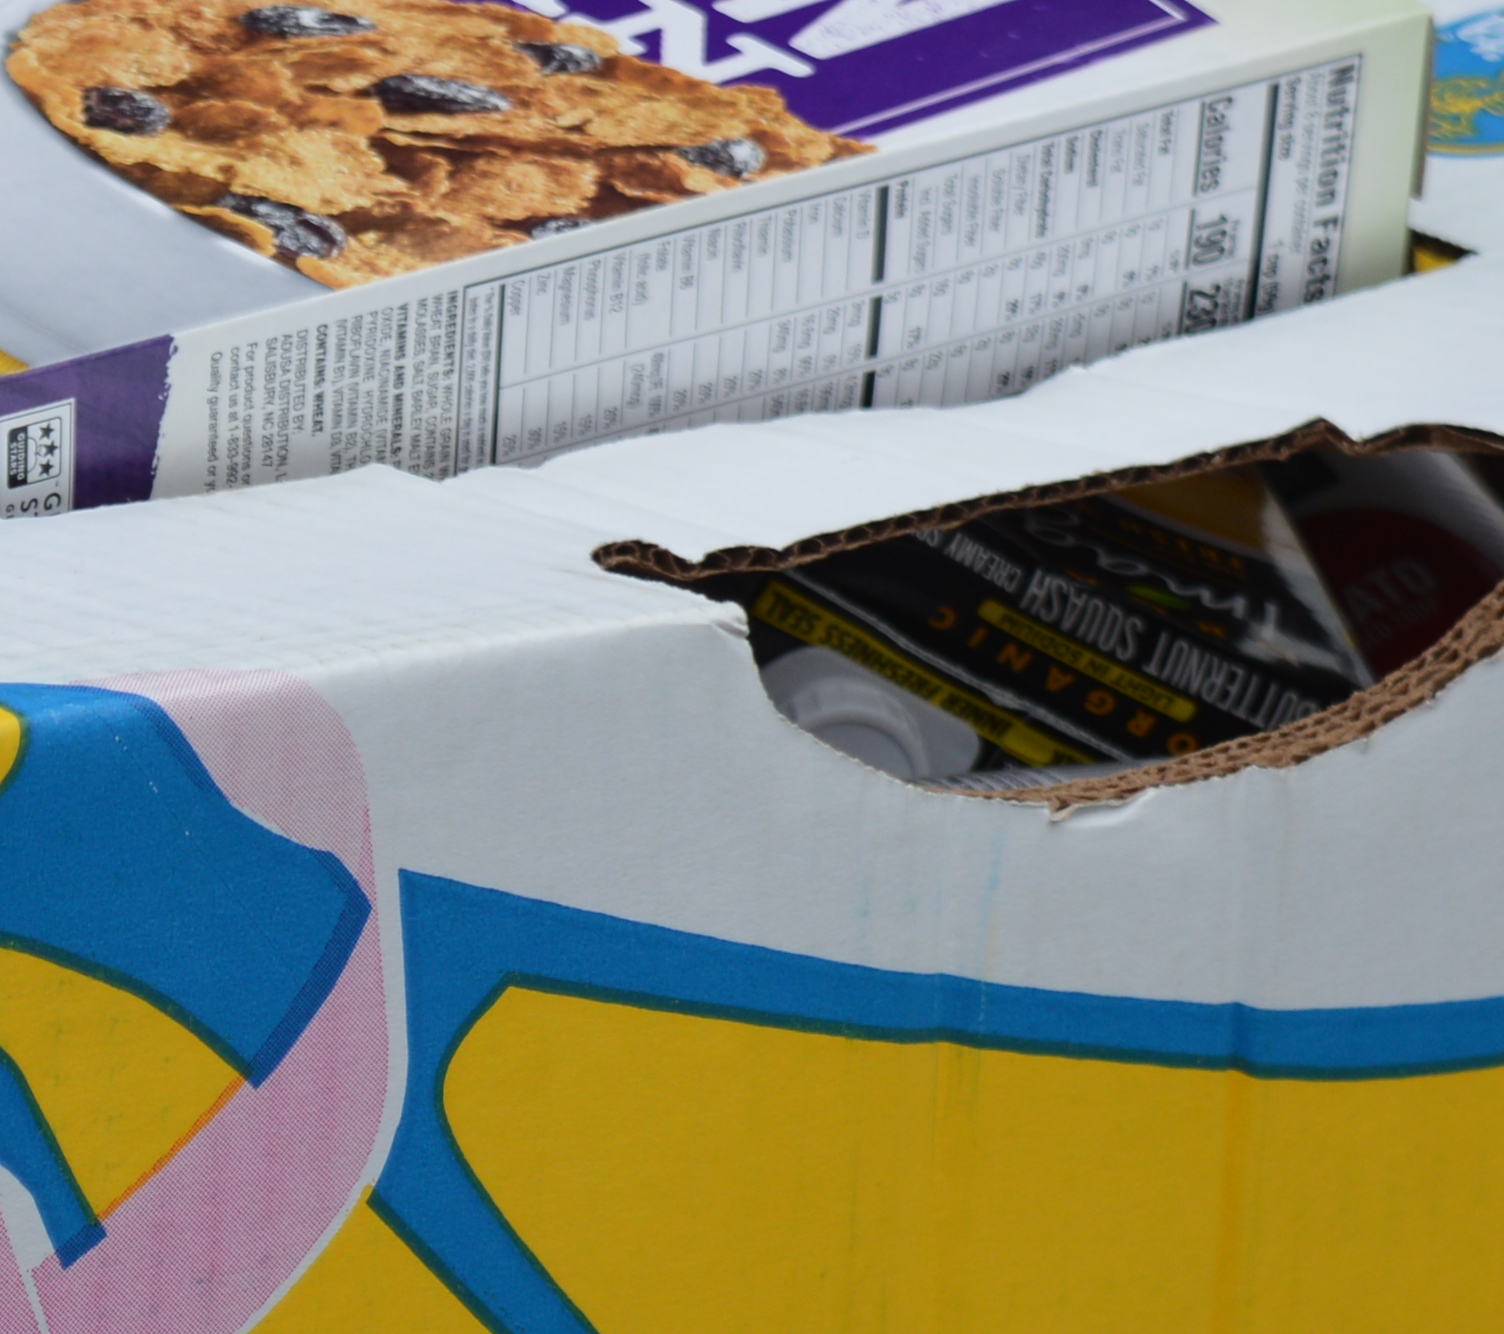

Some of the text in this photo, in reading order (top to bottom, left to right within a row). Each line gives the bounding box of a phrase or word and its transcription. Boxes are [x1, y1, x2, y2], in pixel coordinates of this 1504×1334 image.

[1192, 95, 1233, 267] Calories 190
[1314, 64, 1355, 208] Nutrition
[1301, 216, 1339, 305] Facts
[205, 351, 223, 477] Quality guaranteed or
[227, 347, 240, 423] contact us at
[242, 342, 259, 471] For product questions
[260, 337, 278, 468] SALISBURY, NC 28147
[274, 334, 294, 471] ADUSA DISTRIBUTION,
[293, 329, 308, 412] DISTRIBUTED
[8, 441, 18, 476] STARS
[16, 432, 26, 481] GUIDING
[766, 589, 822, 643] SEAL
[944, 531, 1144, 662] SQUASH CREAMY
[925, 607, 1199, 757] ORGANIC
